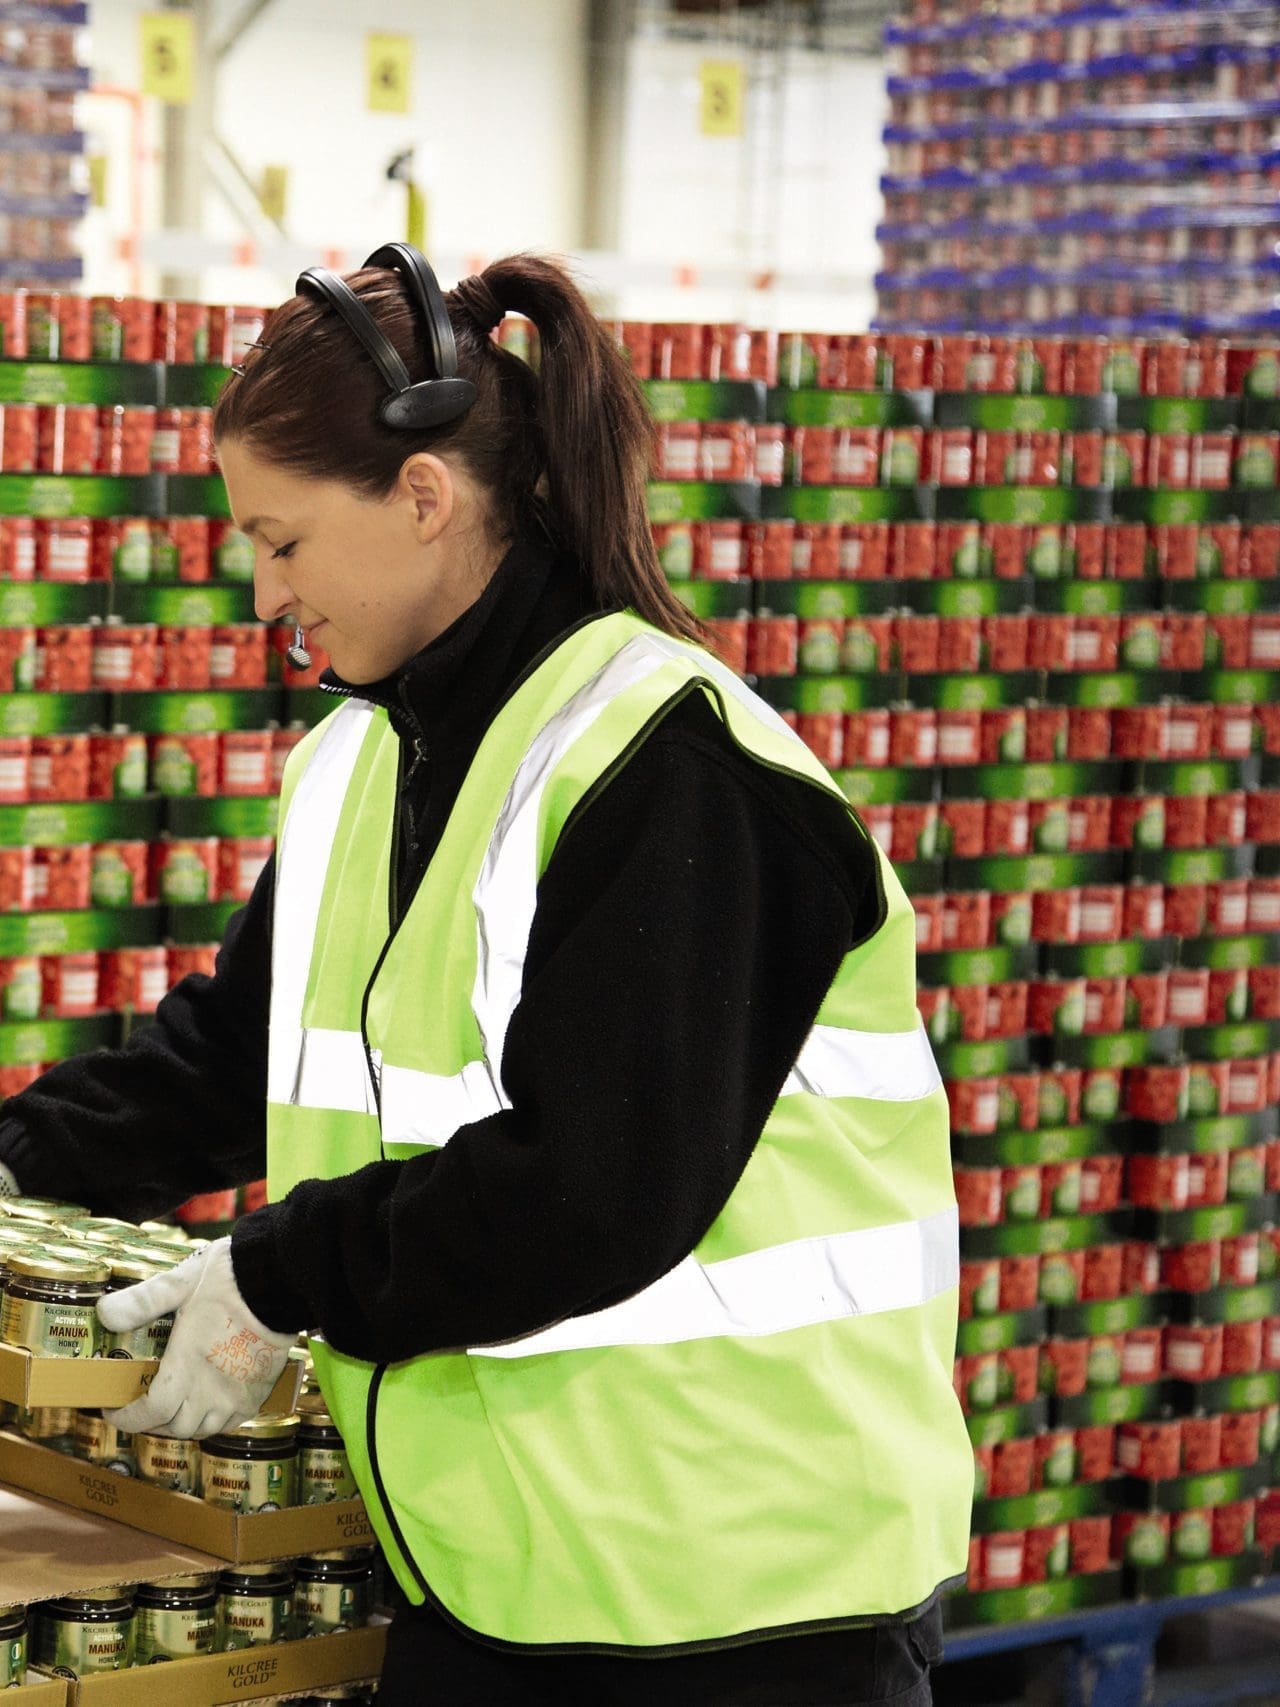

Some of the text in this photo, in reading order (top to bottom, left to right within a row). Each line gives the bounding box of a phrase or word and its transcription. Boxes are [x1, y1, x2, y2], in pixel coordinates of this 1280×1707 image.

[55, 1316, 76, 1325] ACTIVE
[49, 1325, 89, 1338] MANUKA
[58, 1340, 79, 1348] HONEY
[151, 1456, 189, 1470] MANUKA
[305, 1469, 345, 1480] MANUKA
[212, 1475, 251, 1490] MANUKA
[337, 1511, 368, 1526] KILC
[224, 1615, 265, 1628] MANUKA
[89, 1642, 127, 1655] MANUKA
[228, 1658, 278, 1677] KILCREE
